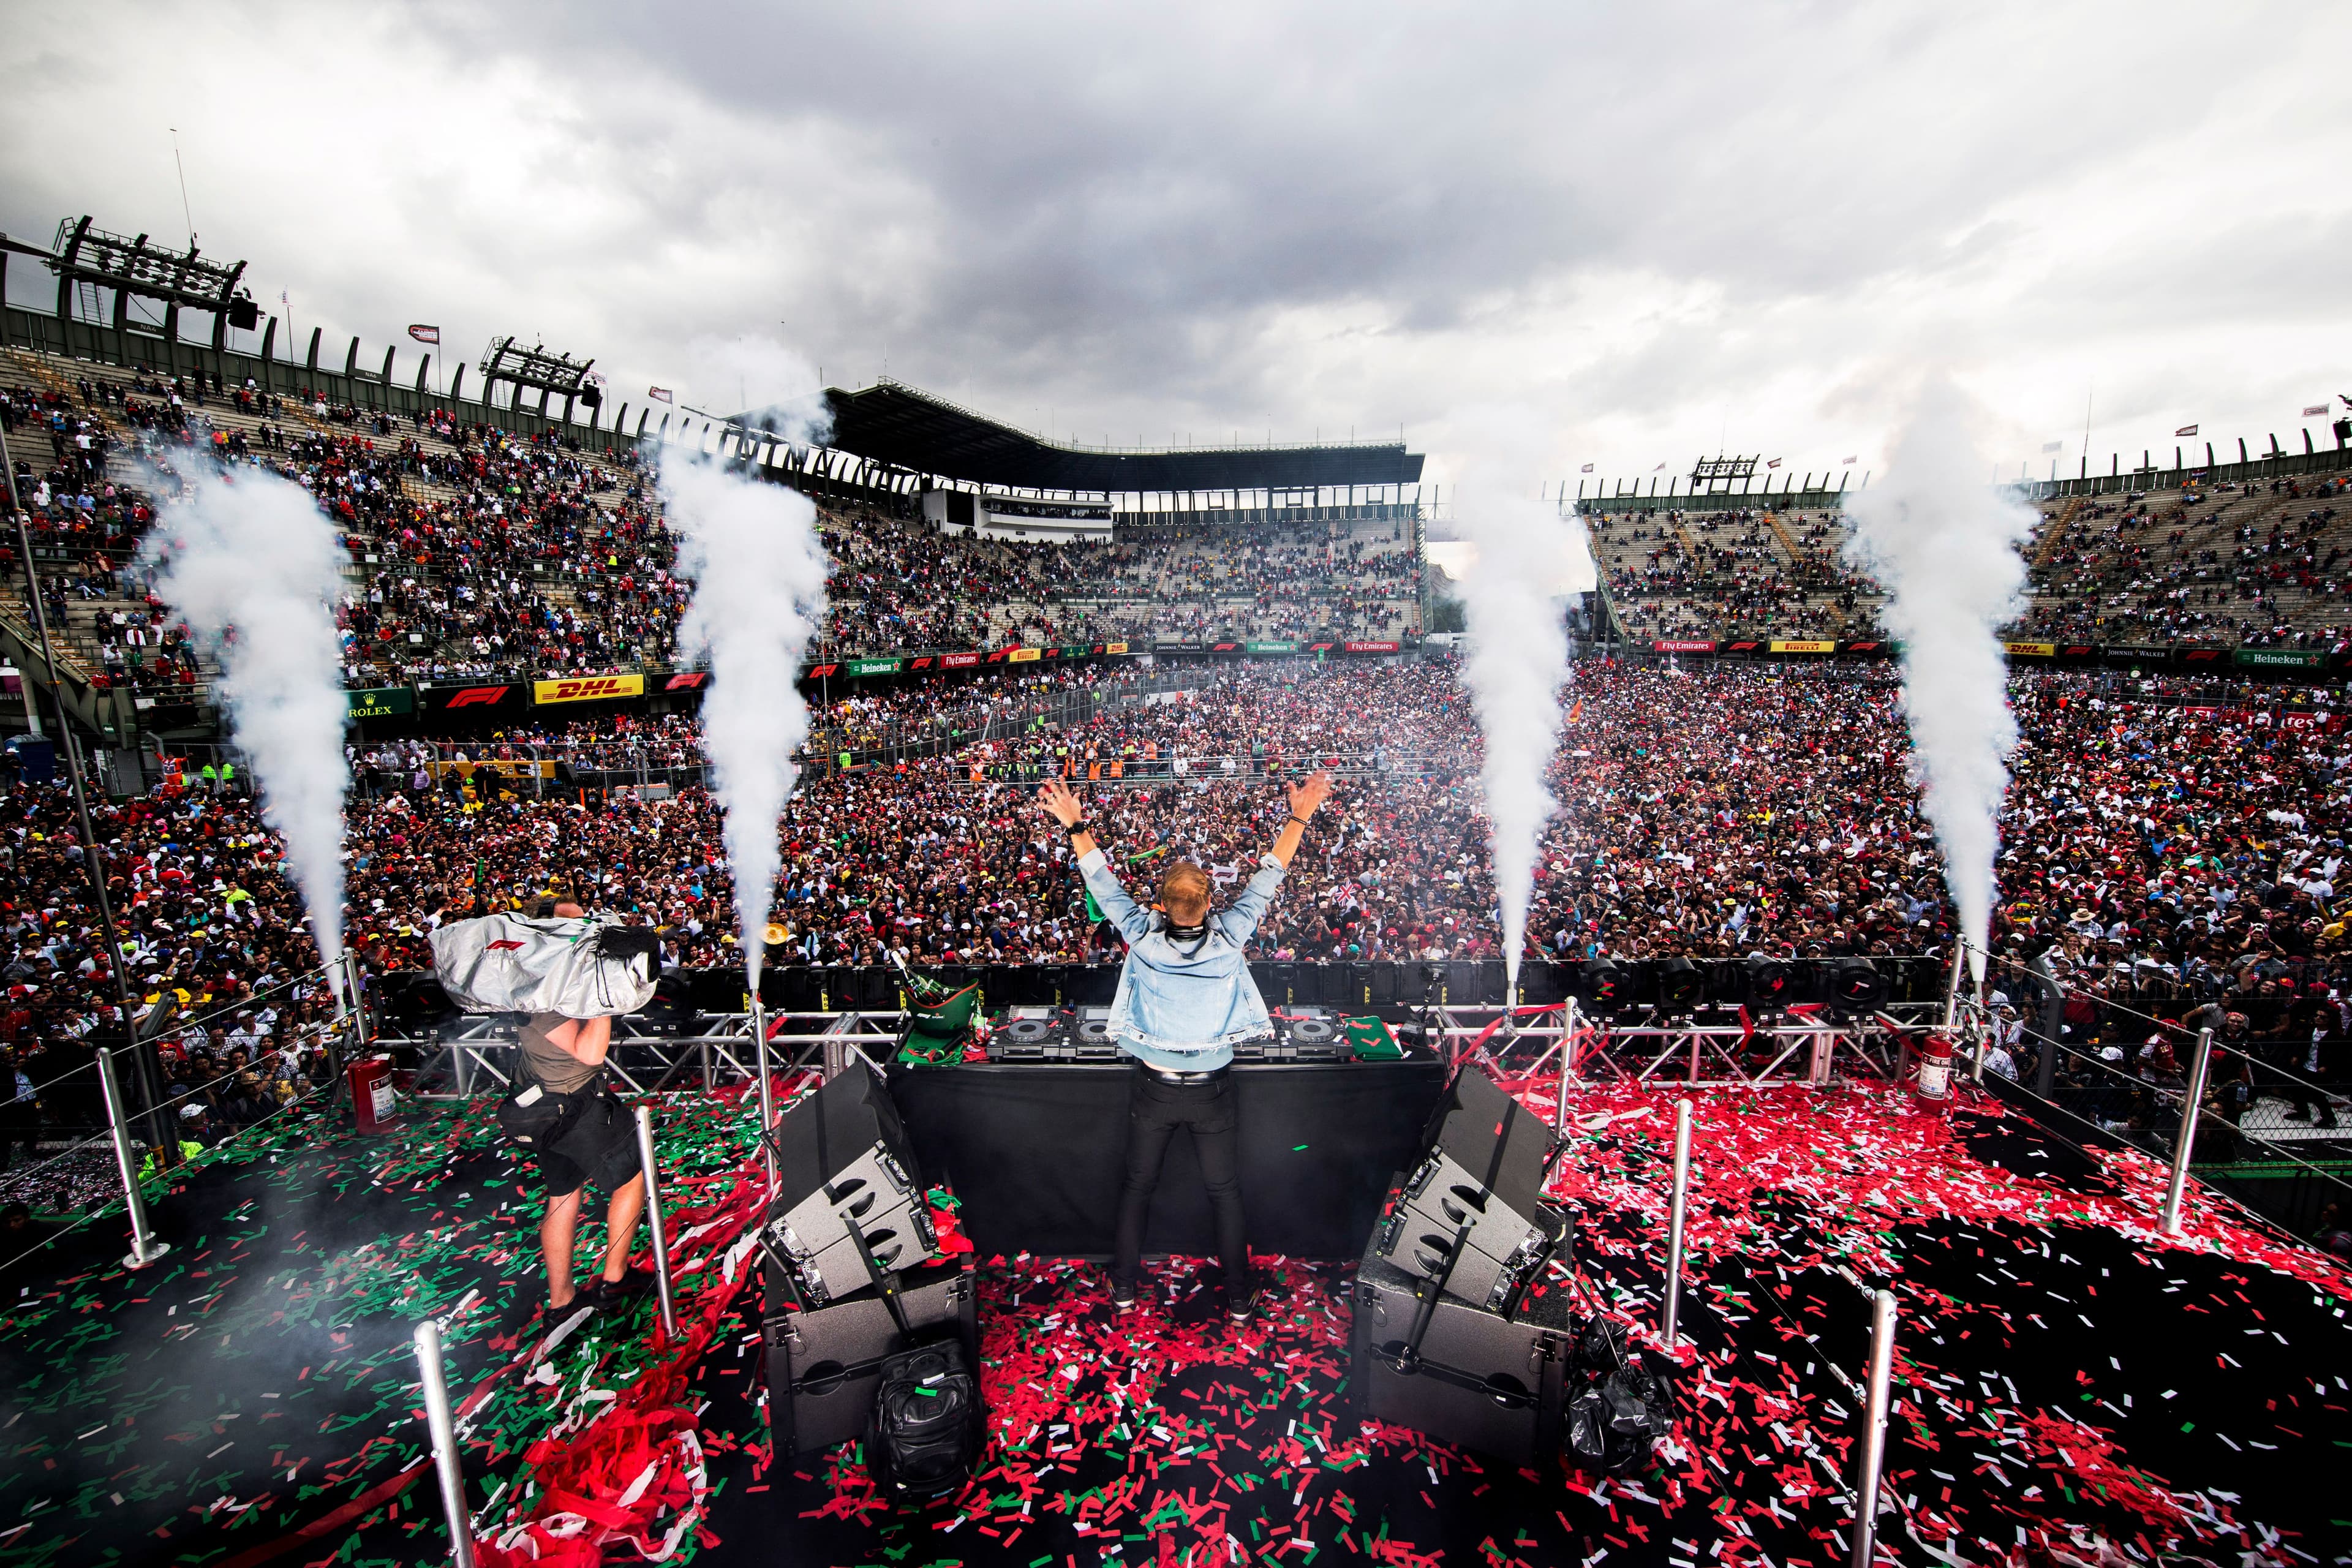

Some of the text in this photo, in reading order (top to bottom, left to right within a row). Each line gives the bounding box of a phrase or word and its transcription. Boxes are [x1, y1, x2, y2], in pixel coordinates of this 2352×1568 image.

[2009, 644, 2040, 653] DHL
[955, 655, 976, 665] Emirates
[1017, 650, 1034, 660] PIRELLI
[2254, 654, 2303, 665] Heineken
[861, 664, 891, 673] Heineken
[556, 679, 622, 699] DHL
[445, 686, 510, 708] F1
[348, 706, 393, 717] ROLEX
[485, 940, 527, 951] F1
